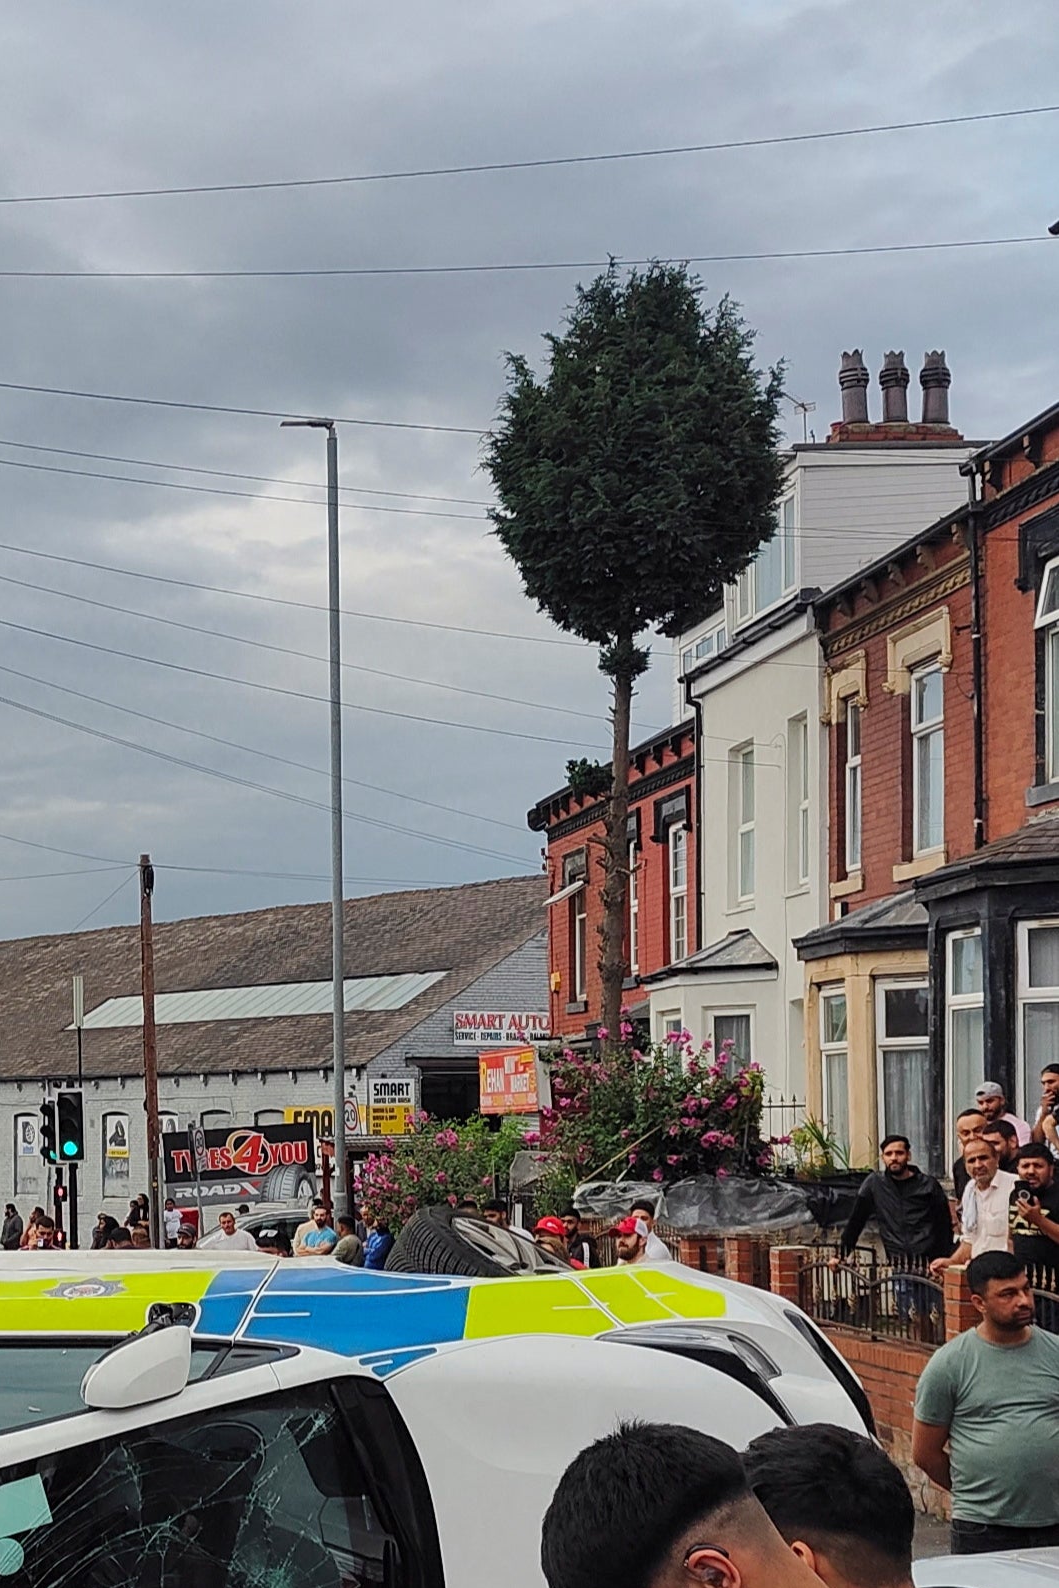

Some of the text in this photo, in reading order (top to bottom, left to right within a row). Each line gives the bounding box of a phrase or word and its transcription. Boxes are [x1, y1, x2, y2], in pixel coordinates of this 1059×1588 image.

[455, 1013, 505, 1030] SMART
[455, 1032, 476, 1040] SERVICE
[481, 1032, 501, 1040] REPAIRS
[373, 1083, 410, 1097] SMART
[345, 1109, 356, 1122] 20
[270, 1141, 308, 1166] YOU
[174, 1181, 261, 1198] ROADX
